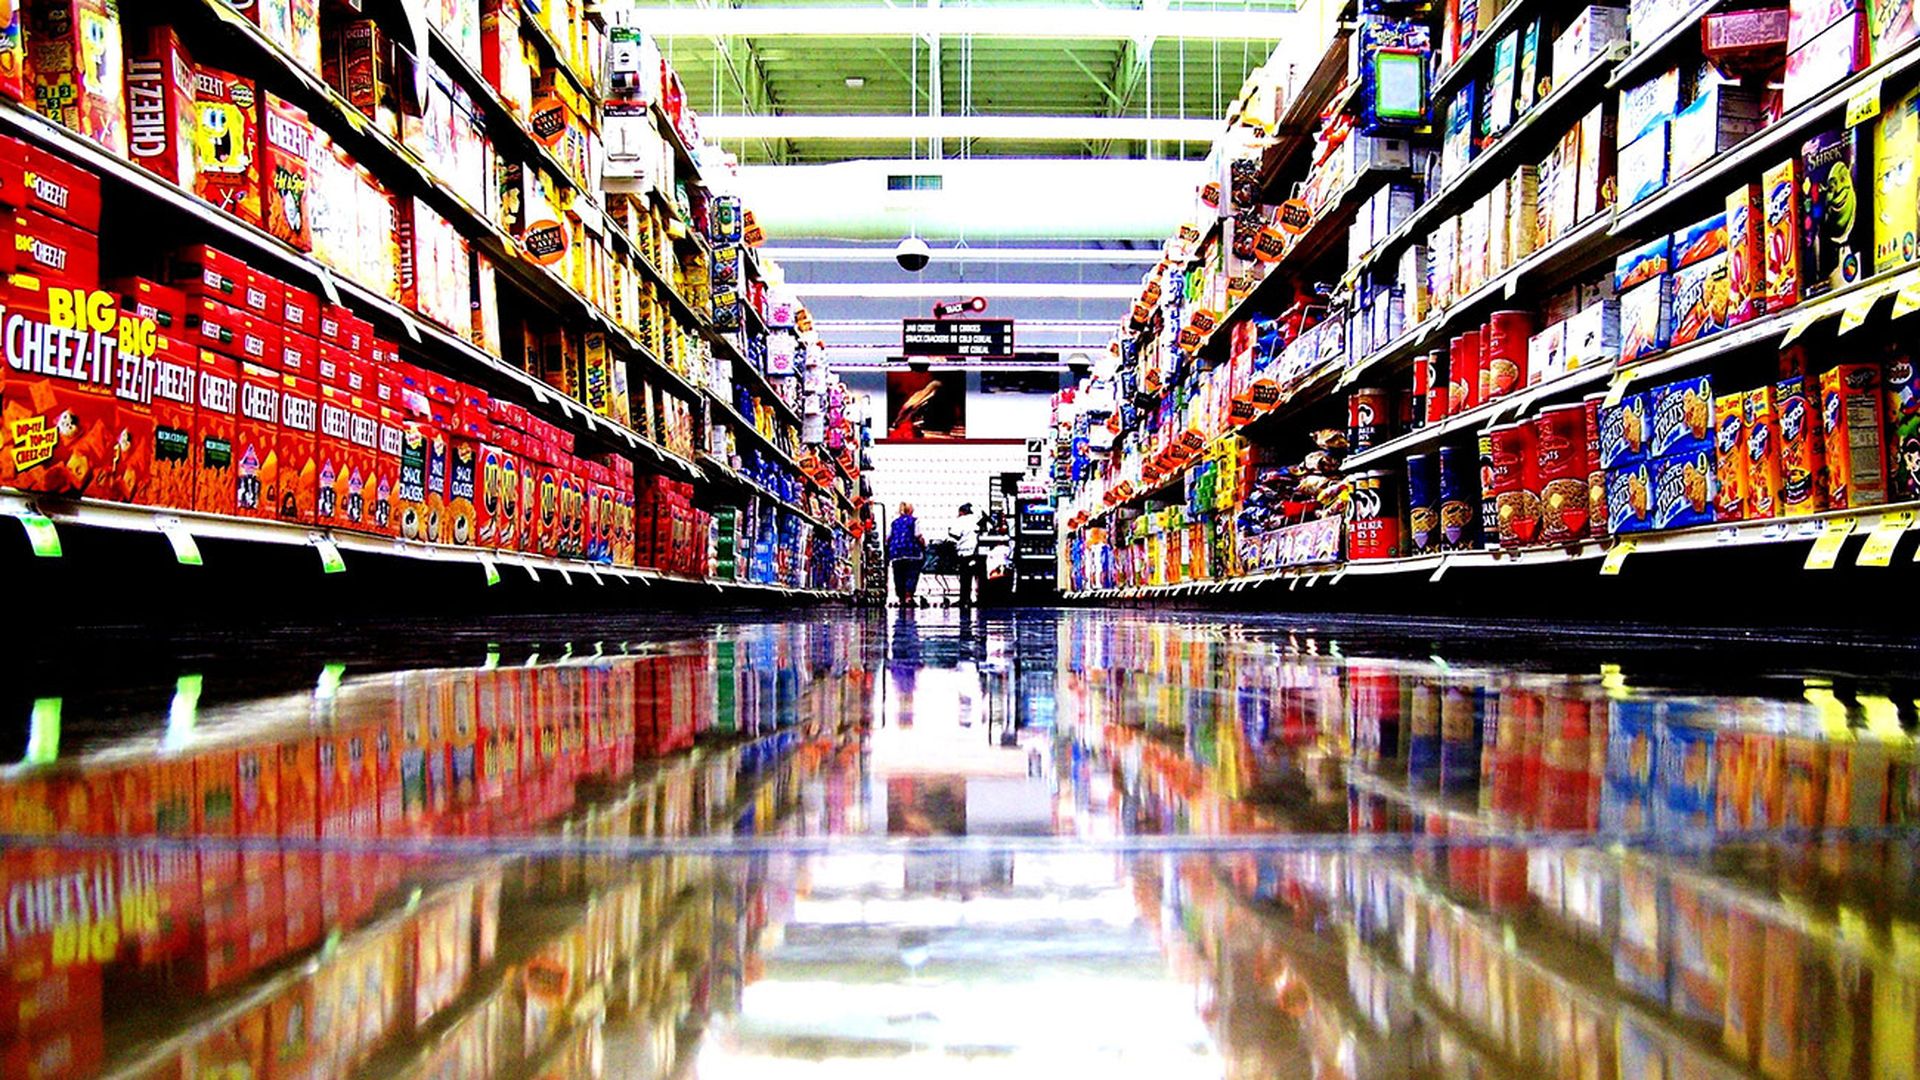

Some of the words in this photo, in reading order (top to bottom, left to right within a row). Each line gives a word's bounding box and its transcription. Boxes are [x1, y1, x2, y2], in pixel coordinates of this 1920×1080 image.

[127, 58, 166, 157] CHEEZ-IT
[1807, 146, 1842, 172] SHREK
[24, 171, 37, 188] IG
[36, 177, 69, 209] CHEEZ-IT
[15, 234, 34, 252] BIG
[33, 240, 67, 270] CHEEZ-IT
[48, 287, 117, 334] BIG
[5, 314, 117, 385] CHEEZ-IT
[119, 316, 157, 357] BIG
[116, 353, 155, 404] EZ-IT
[199, 371, 238, 415] CHEEZ-IT
[241, 381, 280, 424] CHEEZ-IT
[282, 392, 317, 432] CHEEZ-IT
[321, 402, 350, 440] CHEEZ-IT
[1655, 402, 1684, 444] TREATS
[350, 413, 378, 449] CHEEZ-IT
[403, 466, 422, 485] SNACK
